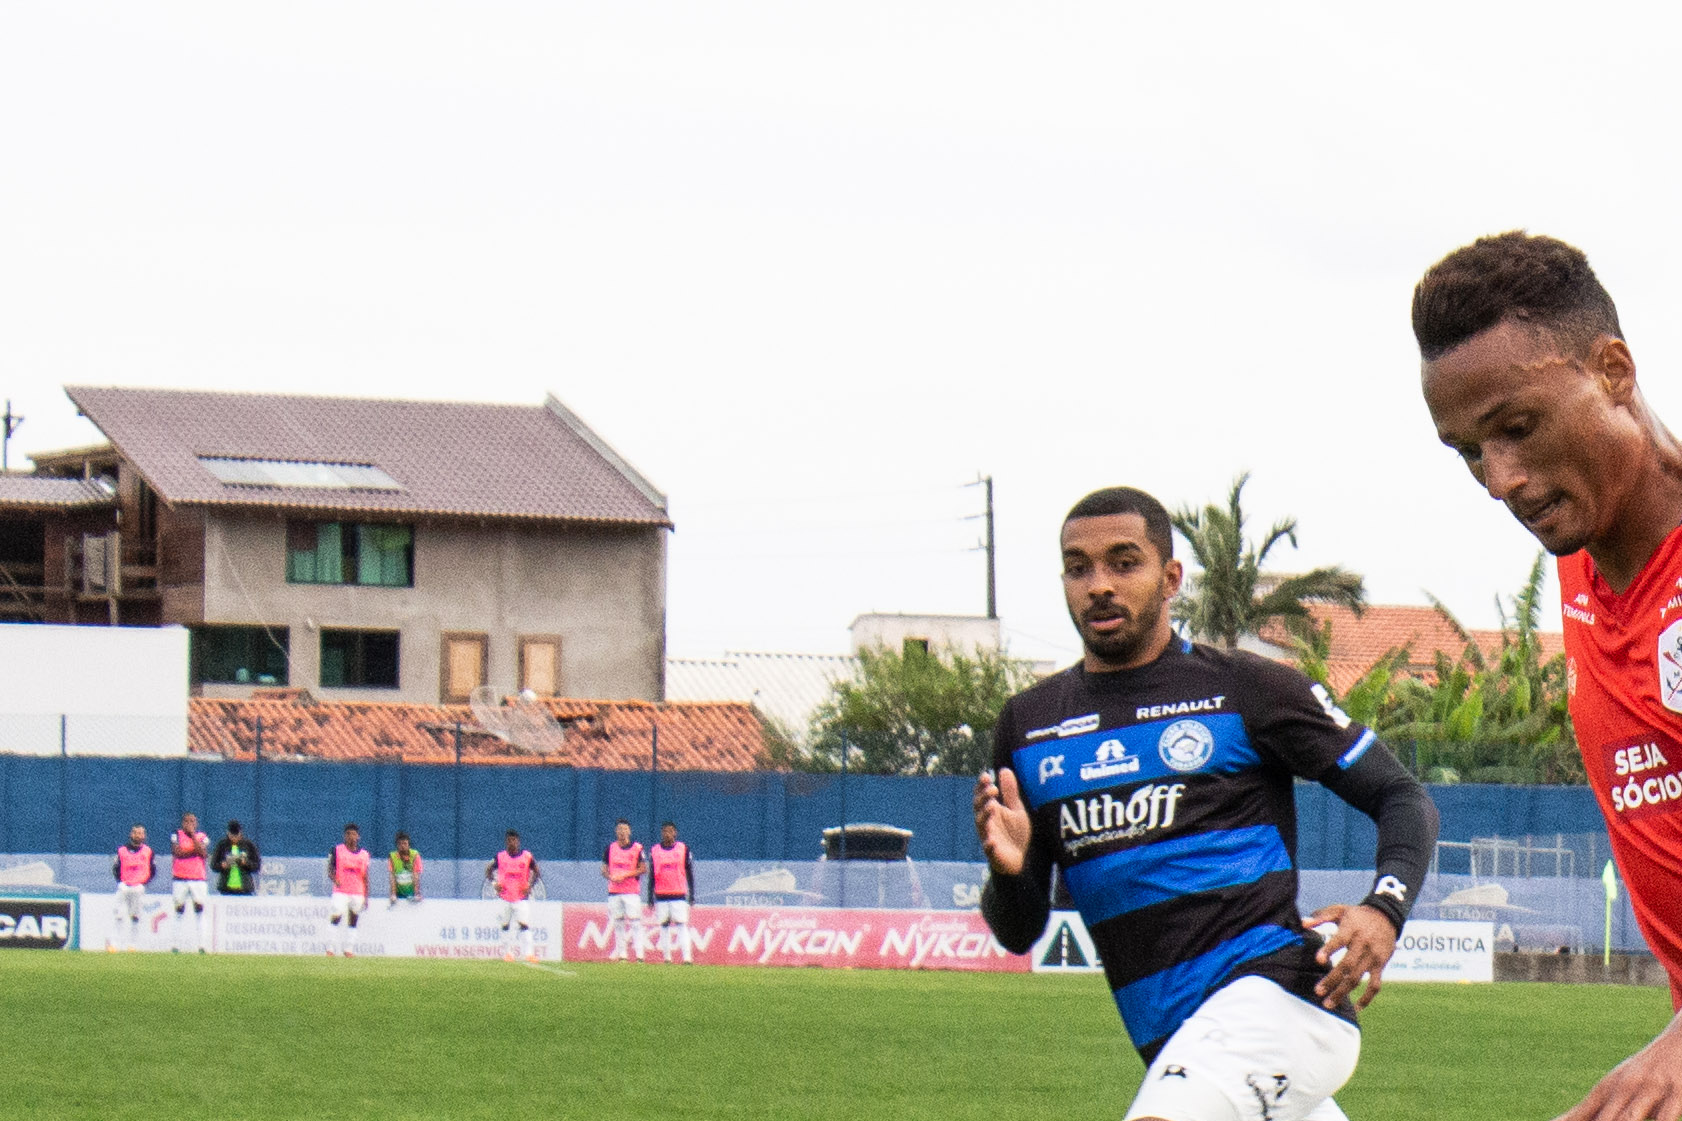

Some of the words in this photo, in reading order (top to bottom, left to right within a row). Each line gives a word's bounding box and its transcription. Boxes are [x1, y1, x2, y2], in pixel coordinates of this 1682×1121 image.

[1136, 695, 1226, 720] RENAULT
[1080, 758, 1140, 781] Unimed
[1615, 742, 1668, 775] SEJA
[1060, 783, 1187, 839] Althoff
